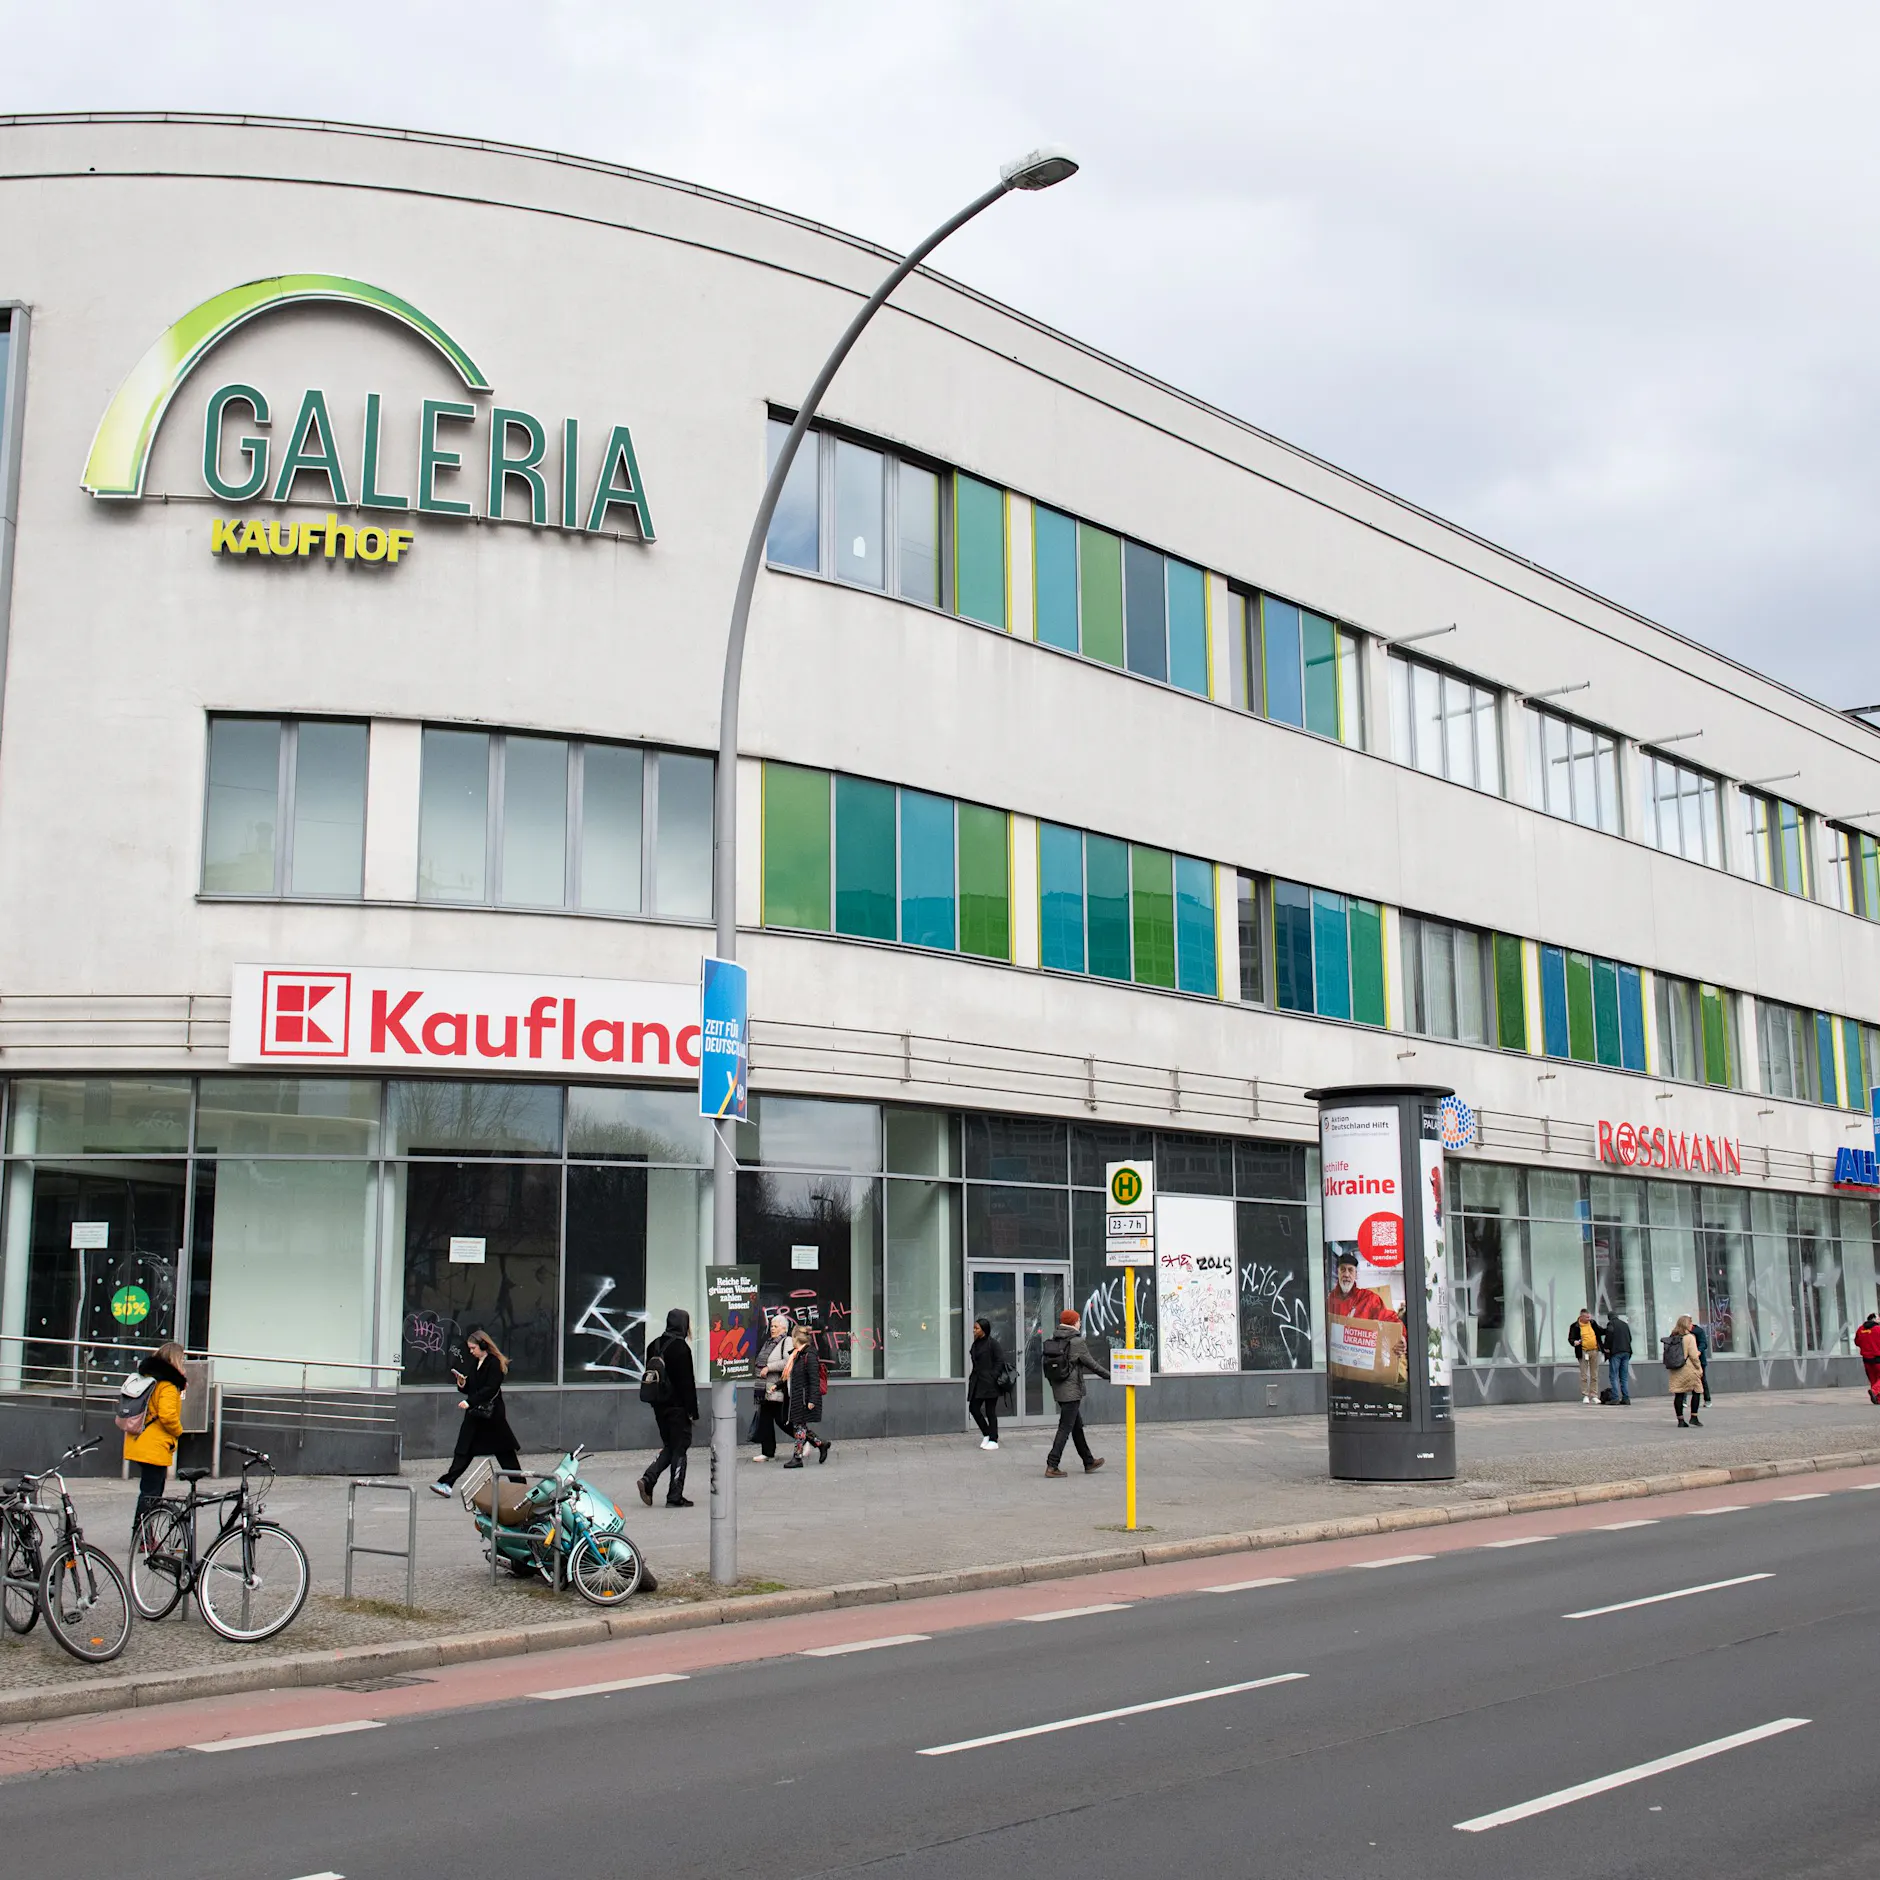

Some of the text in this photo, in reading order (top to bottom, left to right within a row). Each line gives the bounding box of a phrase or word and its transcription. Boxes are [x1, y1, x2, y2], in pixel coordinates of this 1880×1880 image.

[201, 383, 657, 543] GALERIA
[705, 1019, 724, 1036] ZEIT
[1331, 1121, 1390, 1131] Deutschland Hilft
[1597, 1120, 1740, 1175] ROSSMANN
[1118, 1176, 1133, 1197] H
[1324, 1175, 1395, 1197] Ukraine
[1112, 1220, 1122, 1230] 23
[1128, 1220, 1134, 1229] 7
[1136, 1220, 1142, 1229] h
[716, 1276, 751, 1286] Reiche für
[708, 1285, 758, 1296] grünen Wandel
[719, 1294, 742, 1302] zahlen
[113, 1302, 147, 1316] 30%
[728, 1301, 750, 1310] lassen!
